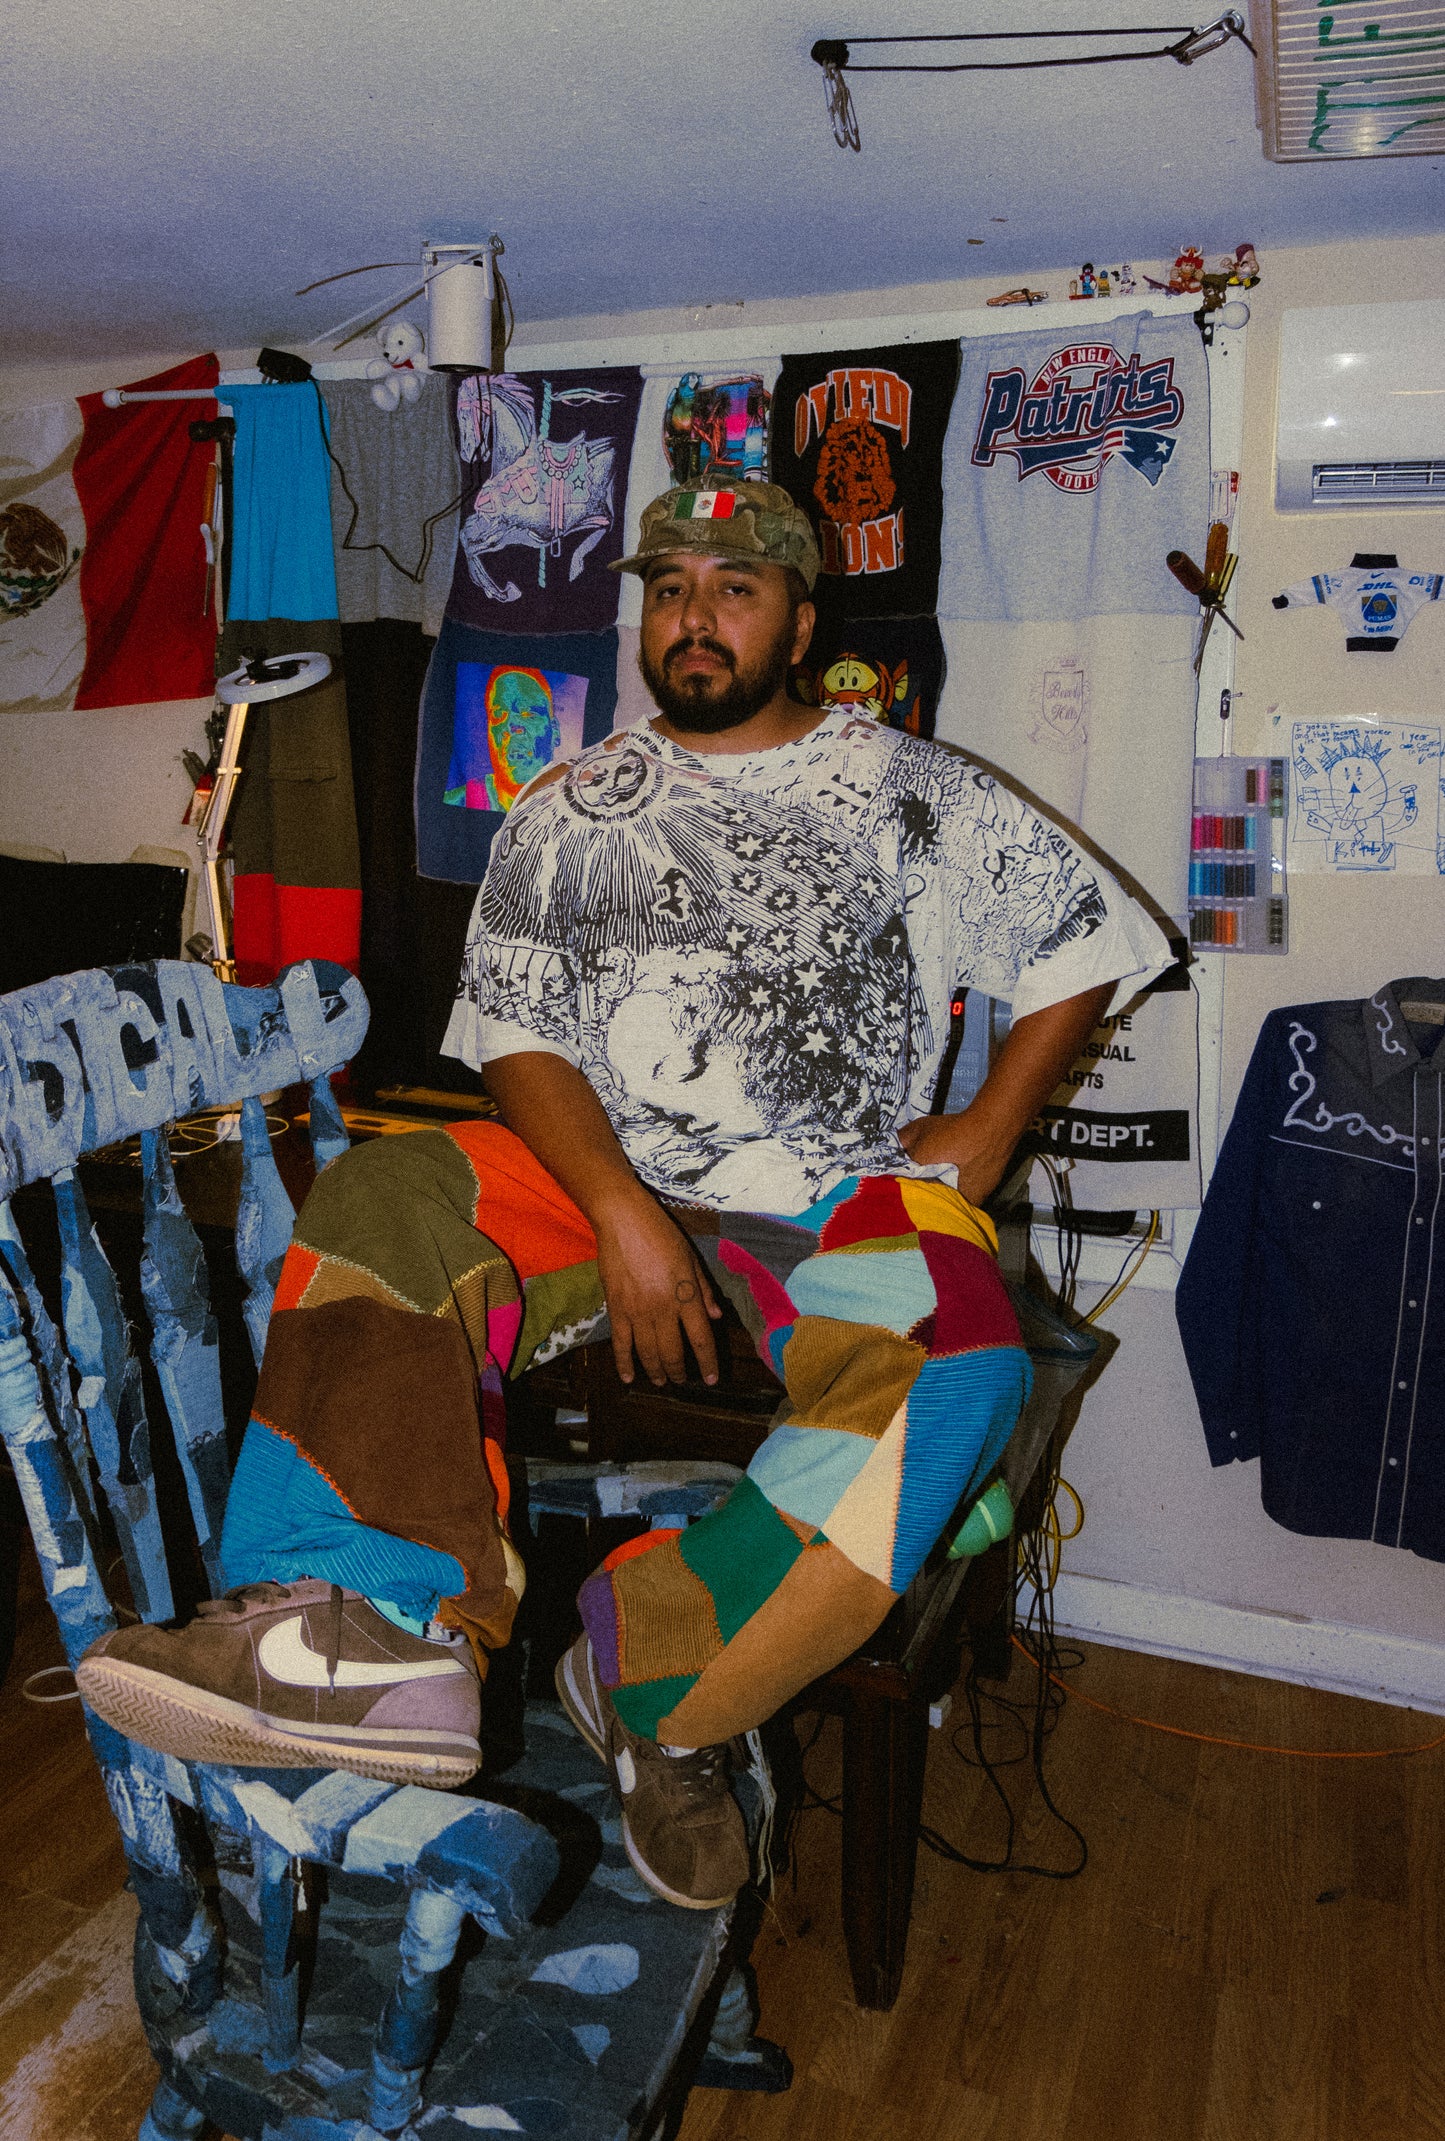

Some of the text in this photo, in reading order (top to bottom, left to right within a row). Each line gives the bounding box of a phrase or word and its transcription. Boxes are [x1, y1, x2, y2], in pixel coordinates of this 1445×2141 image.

[1040, 348, 1115, 385] NEW ENGLA
[1056, 470, 1099, 490] FOOTB
[820, 506, 904, 575] ION
[1070, 1121, 1154, 1148] DEPT.
